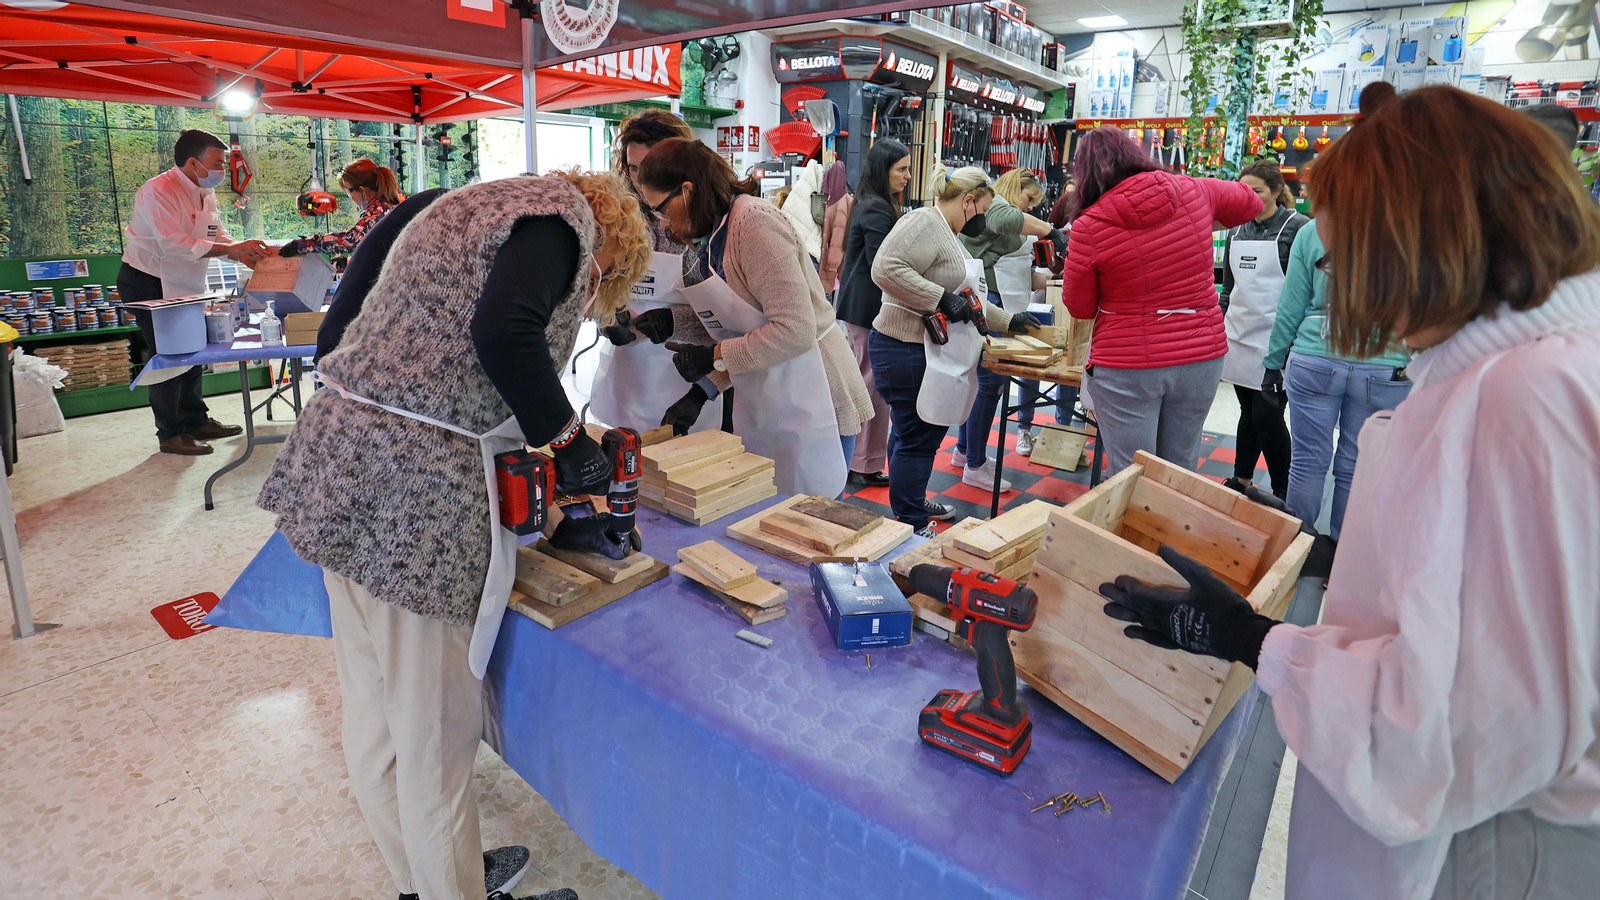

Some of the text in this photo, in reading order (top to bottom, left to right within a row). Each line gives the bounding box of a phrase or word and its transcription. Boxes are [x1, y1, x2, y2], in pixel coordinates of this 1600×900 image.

[791, 56, 836, 70] BELLOTA
[896, 57, 934, 81] BELLOTA
[957, 78, 980, 93] BELLOTA
[989, 86, 1016, 105] BELLOTA
[1024, 97, 1046, 113] BELLOTA
[983, 602, 1005, 613] Einhell
